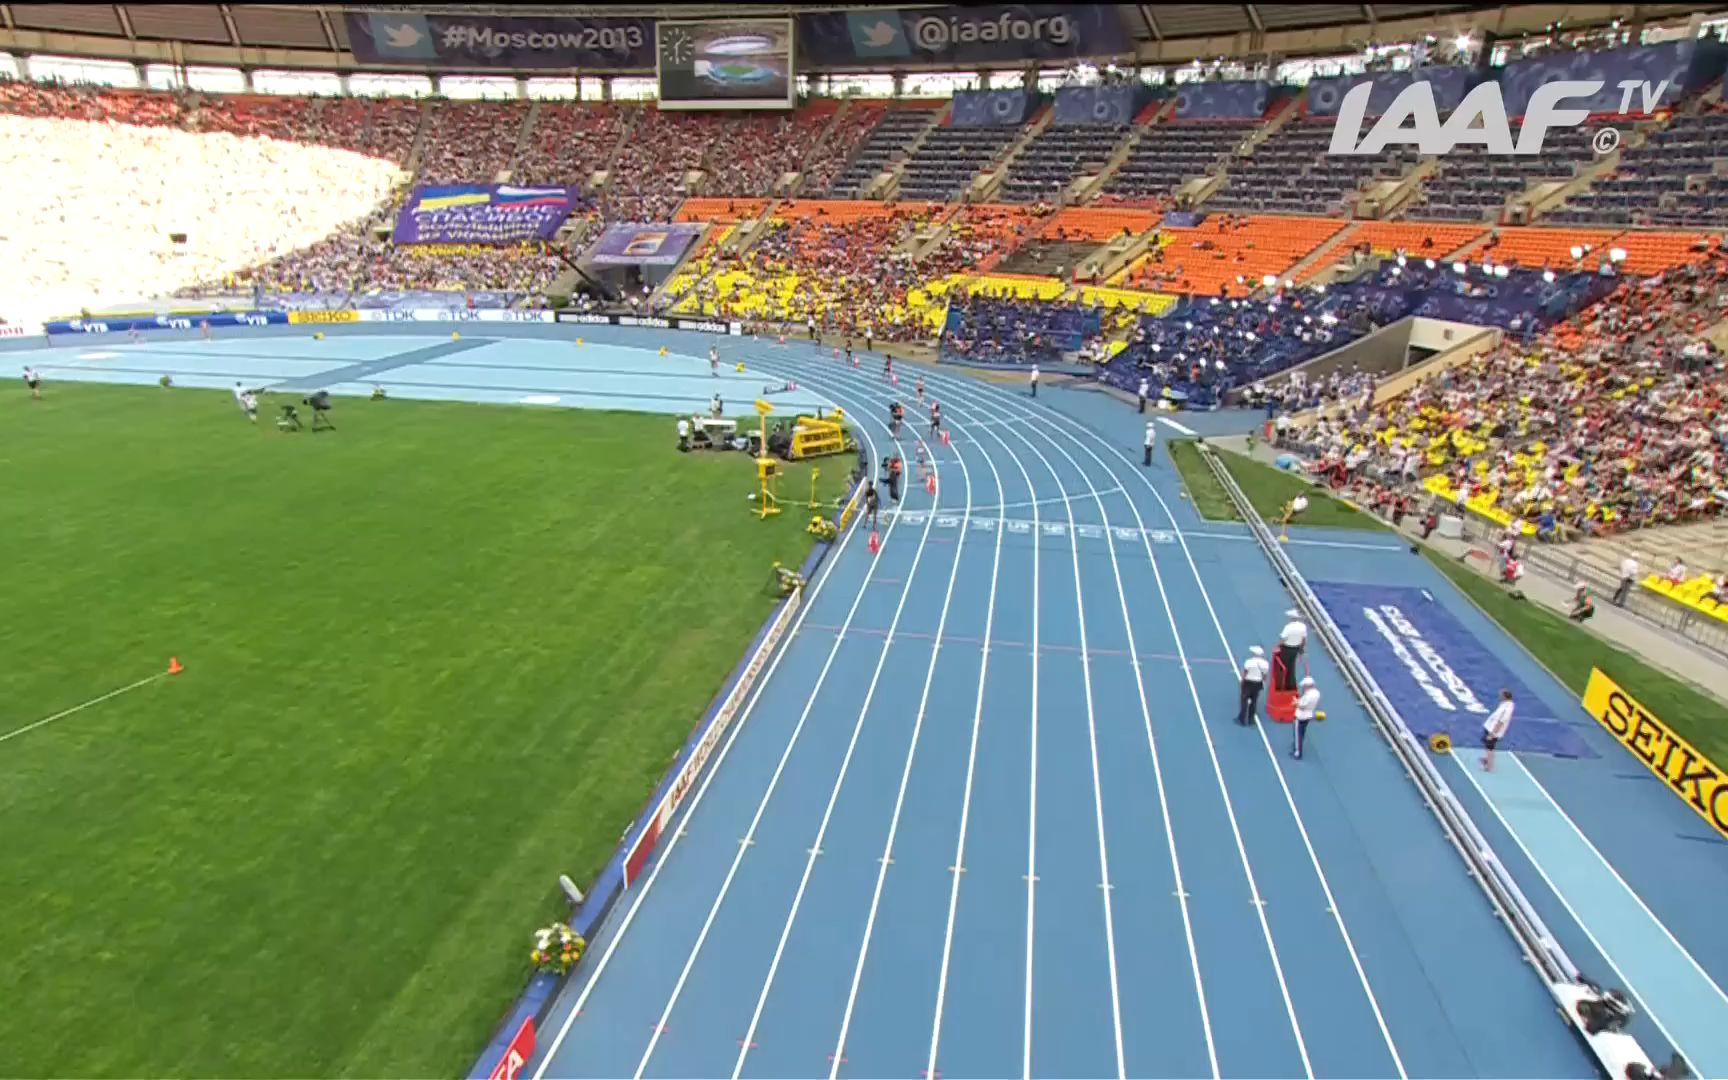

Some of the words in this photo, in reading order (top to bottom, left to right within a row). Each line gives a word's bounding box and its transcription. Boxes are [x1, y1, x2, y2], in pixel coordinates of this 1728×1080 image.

[443, 25, 643, 49] #Moscow2013
[914, 12, 1071, 50] @iaaforg
[246, 316, 268, 326] VTB
[384, 308, 417, 321] TDK
[449, 308, 480, 321] TDK
[515, 308, 543, 321] TDK
[84, 322, 108, 333] VTB
[168, 319, 191, 329] VTB
